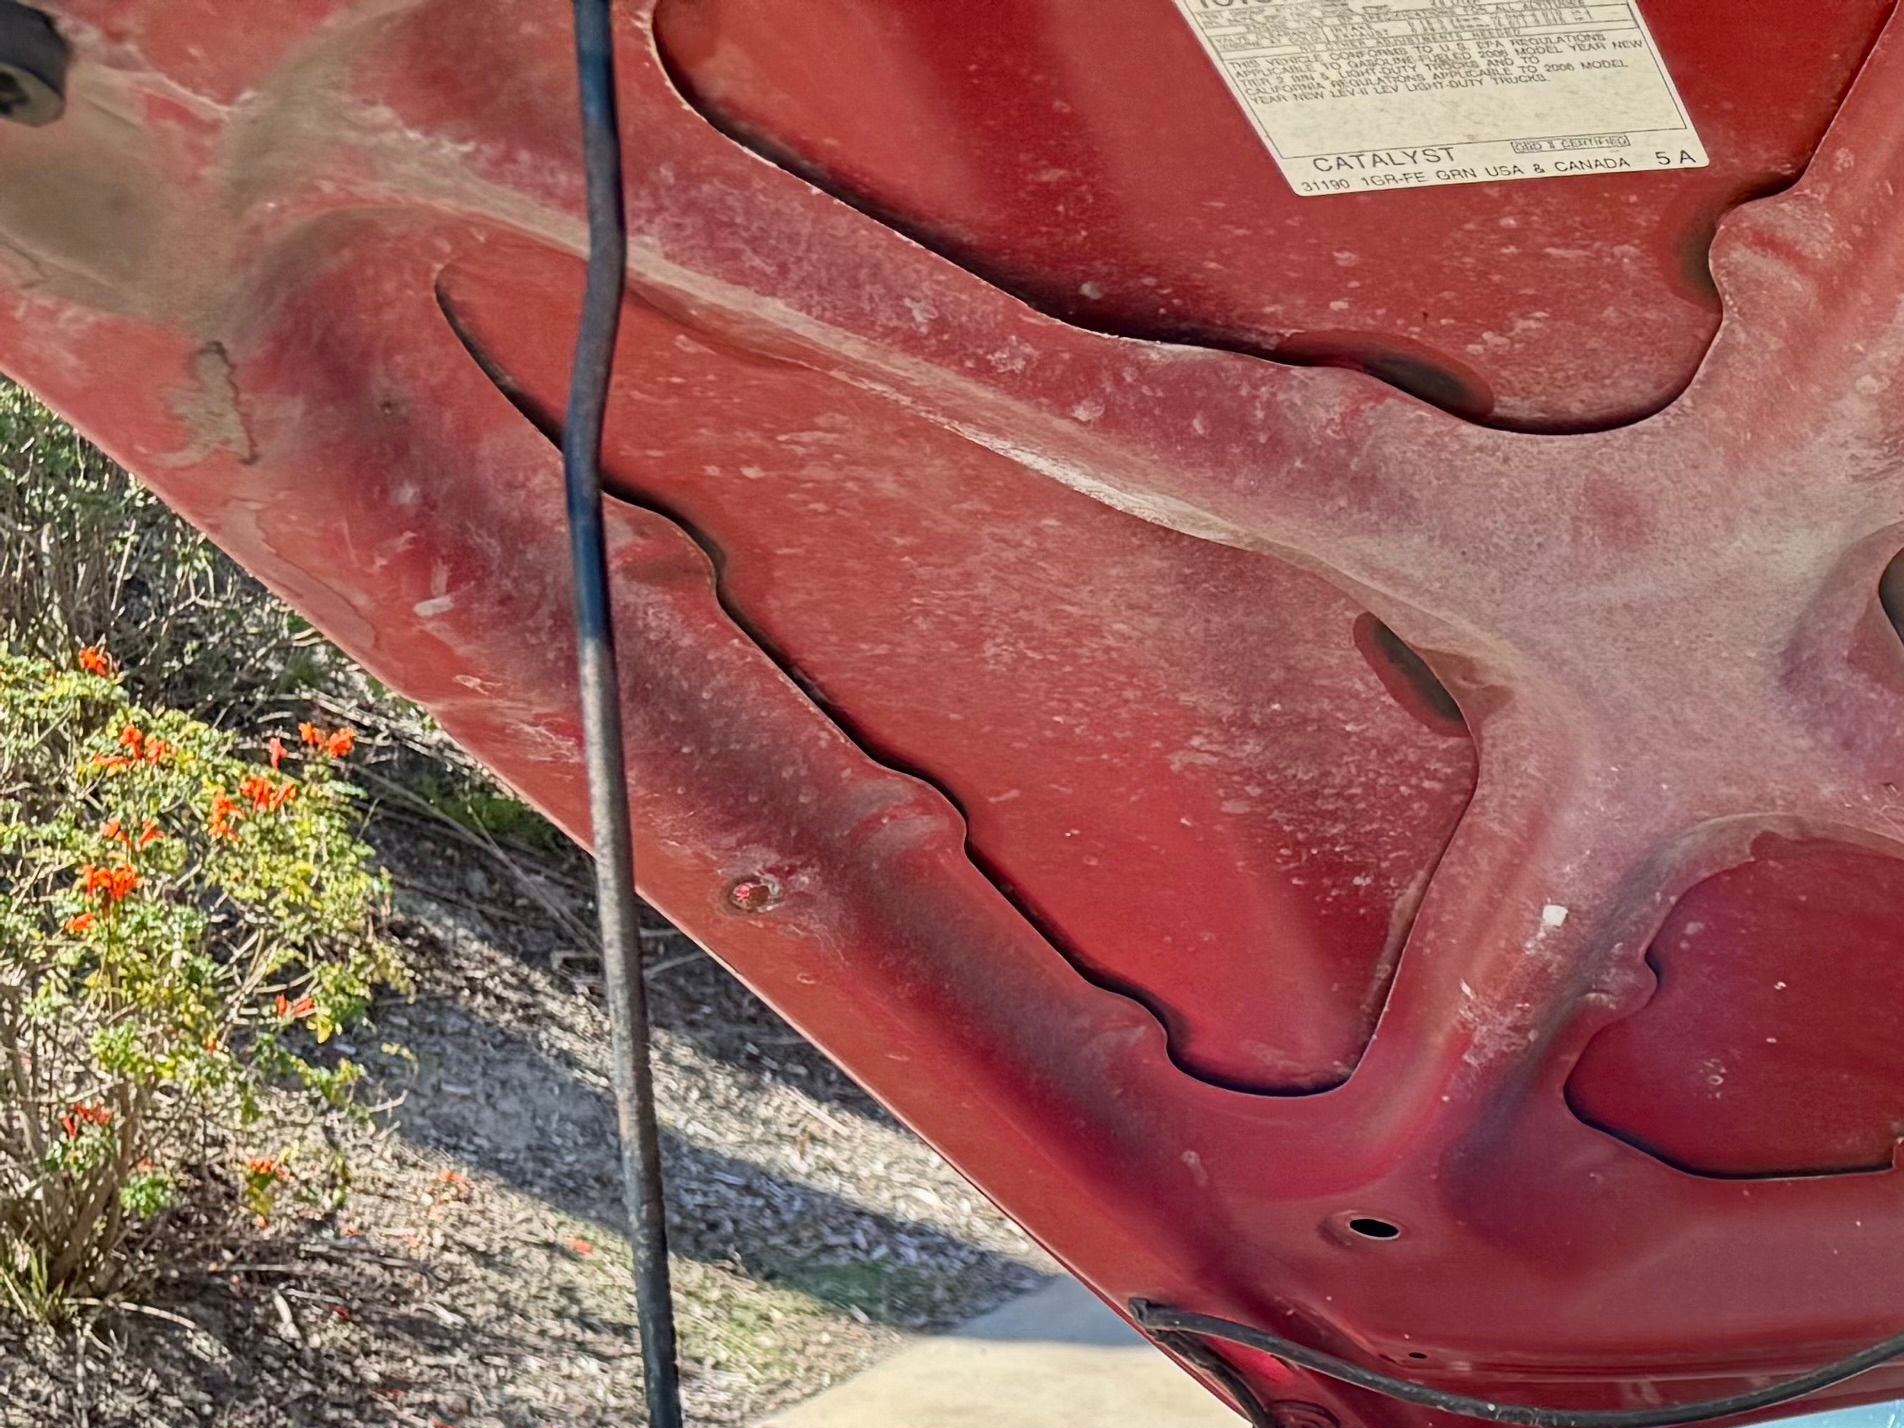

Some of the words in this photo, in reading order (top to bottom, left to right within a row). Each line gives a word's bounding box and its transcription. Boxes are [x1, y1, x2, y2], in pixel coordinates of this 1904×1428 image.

[1323, 60, 1342, 71] TO
[1515, 44, 1565, 57] MODEL
[1570, 42, 1608, 53] YEAR
[1612, 39, 1644, 50] NEW
[1416, 44, 1435, 55] TO
[1510, 33, 1607, 47] REGULATIONS
[1331, 73, 1426, 89] REGULATIONS
[1432, 67, 1514, 82] APPLICABLE
[1519, 64, 1539, 75] TO
[1580, 58, 1629, 70] MODEL
[1484, 57, 1514, 69] AND
[1521, 55, 1541, 66] TO
[1293, 90, 1325, 102] NEW
[1375, 84, 1400, 95] LEV
[1301, 178, 1351, 193] 31190
[1360, 171, 1426, 188] 1GR-FE
[1435, 166, 1478, 182] GRN
[1484, 162, 1525, 178] USA
[1533, 160, 1546, 174] &
[1553, 155, 1632, 172] CANADA
[1655, 150, 1673, 167] 5
[1679, 148, 1698, 165] A
[1312, 146, 1457, 174] CATALYST
